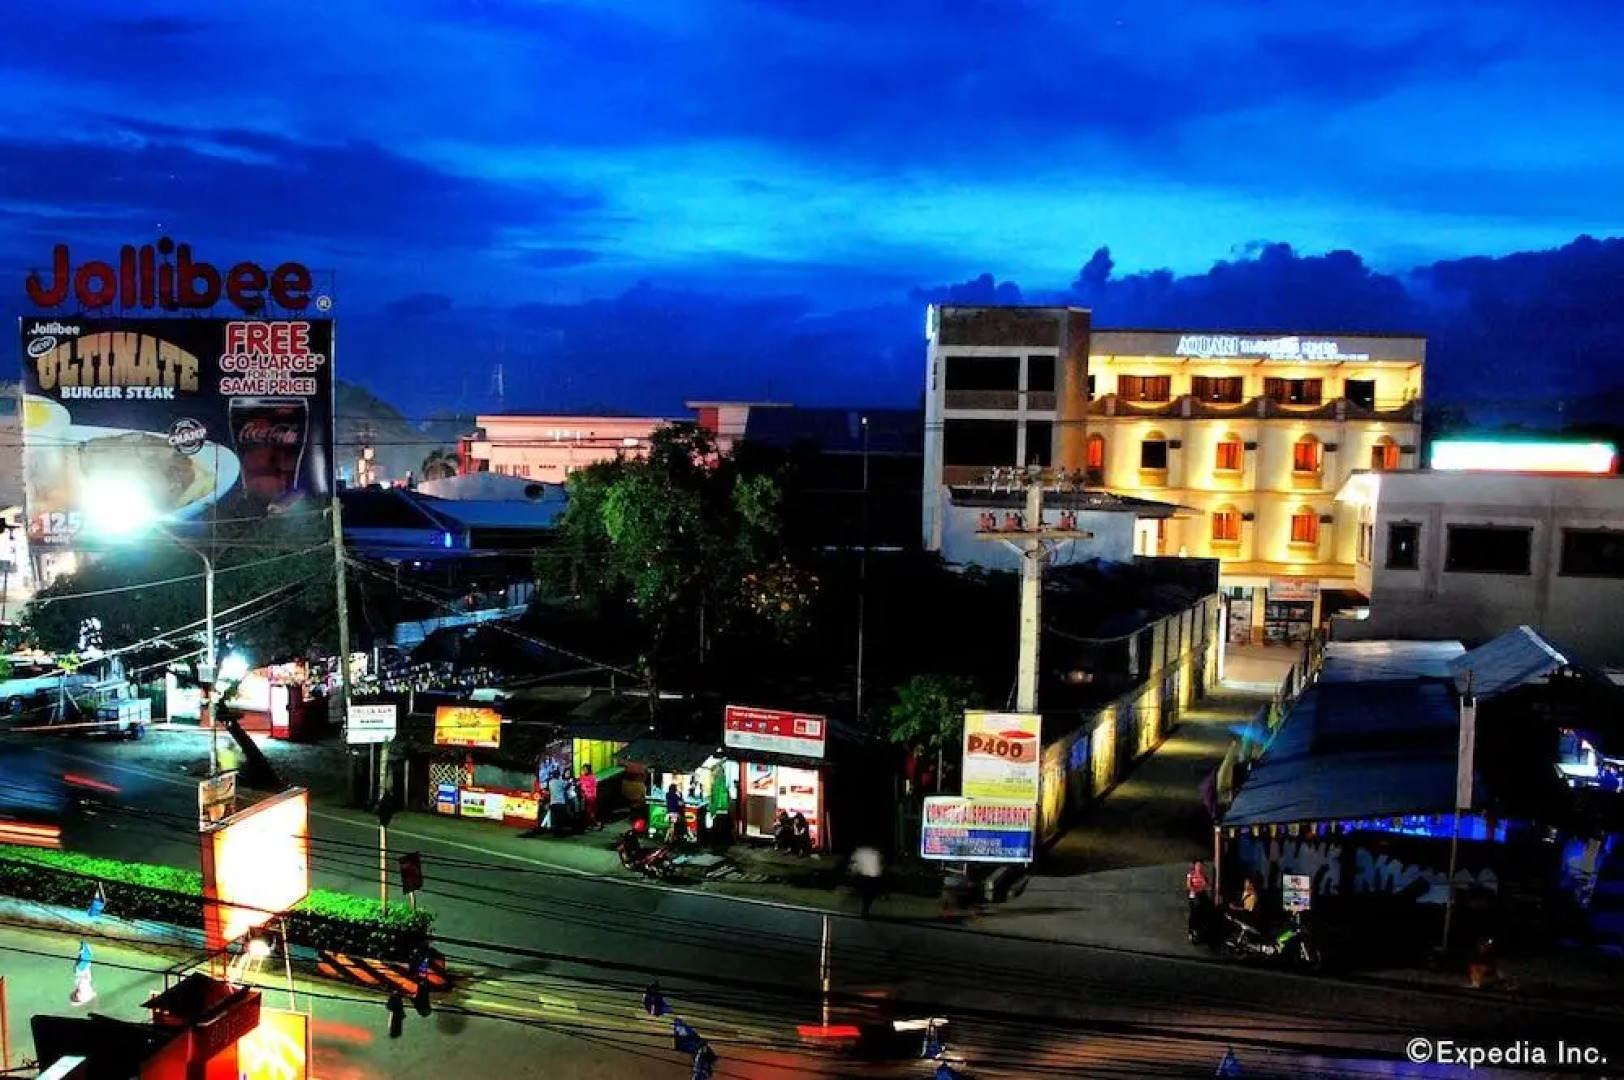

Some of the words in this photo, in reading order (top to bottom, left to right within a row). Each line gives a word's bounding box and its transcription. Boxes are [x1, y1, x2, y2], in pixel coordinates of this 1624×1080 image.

[26, 237, 312, 311] Jollibee
[31, 322, 80, 336] Jollibee
[226, 322, 310, 355] FREE
[37, 331, 199, 391] ULTIMATE
[60, 386, 121, 399] BURGER
[126, 386, 174, 399] STEAK
[220, 377, 266, 395] SAME
[267, 378, 316, 395] PRICE!
